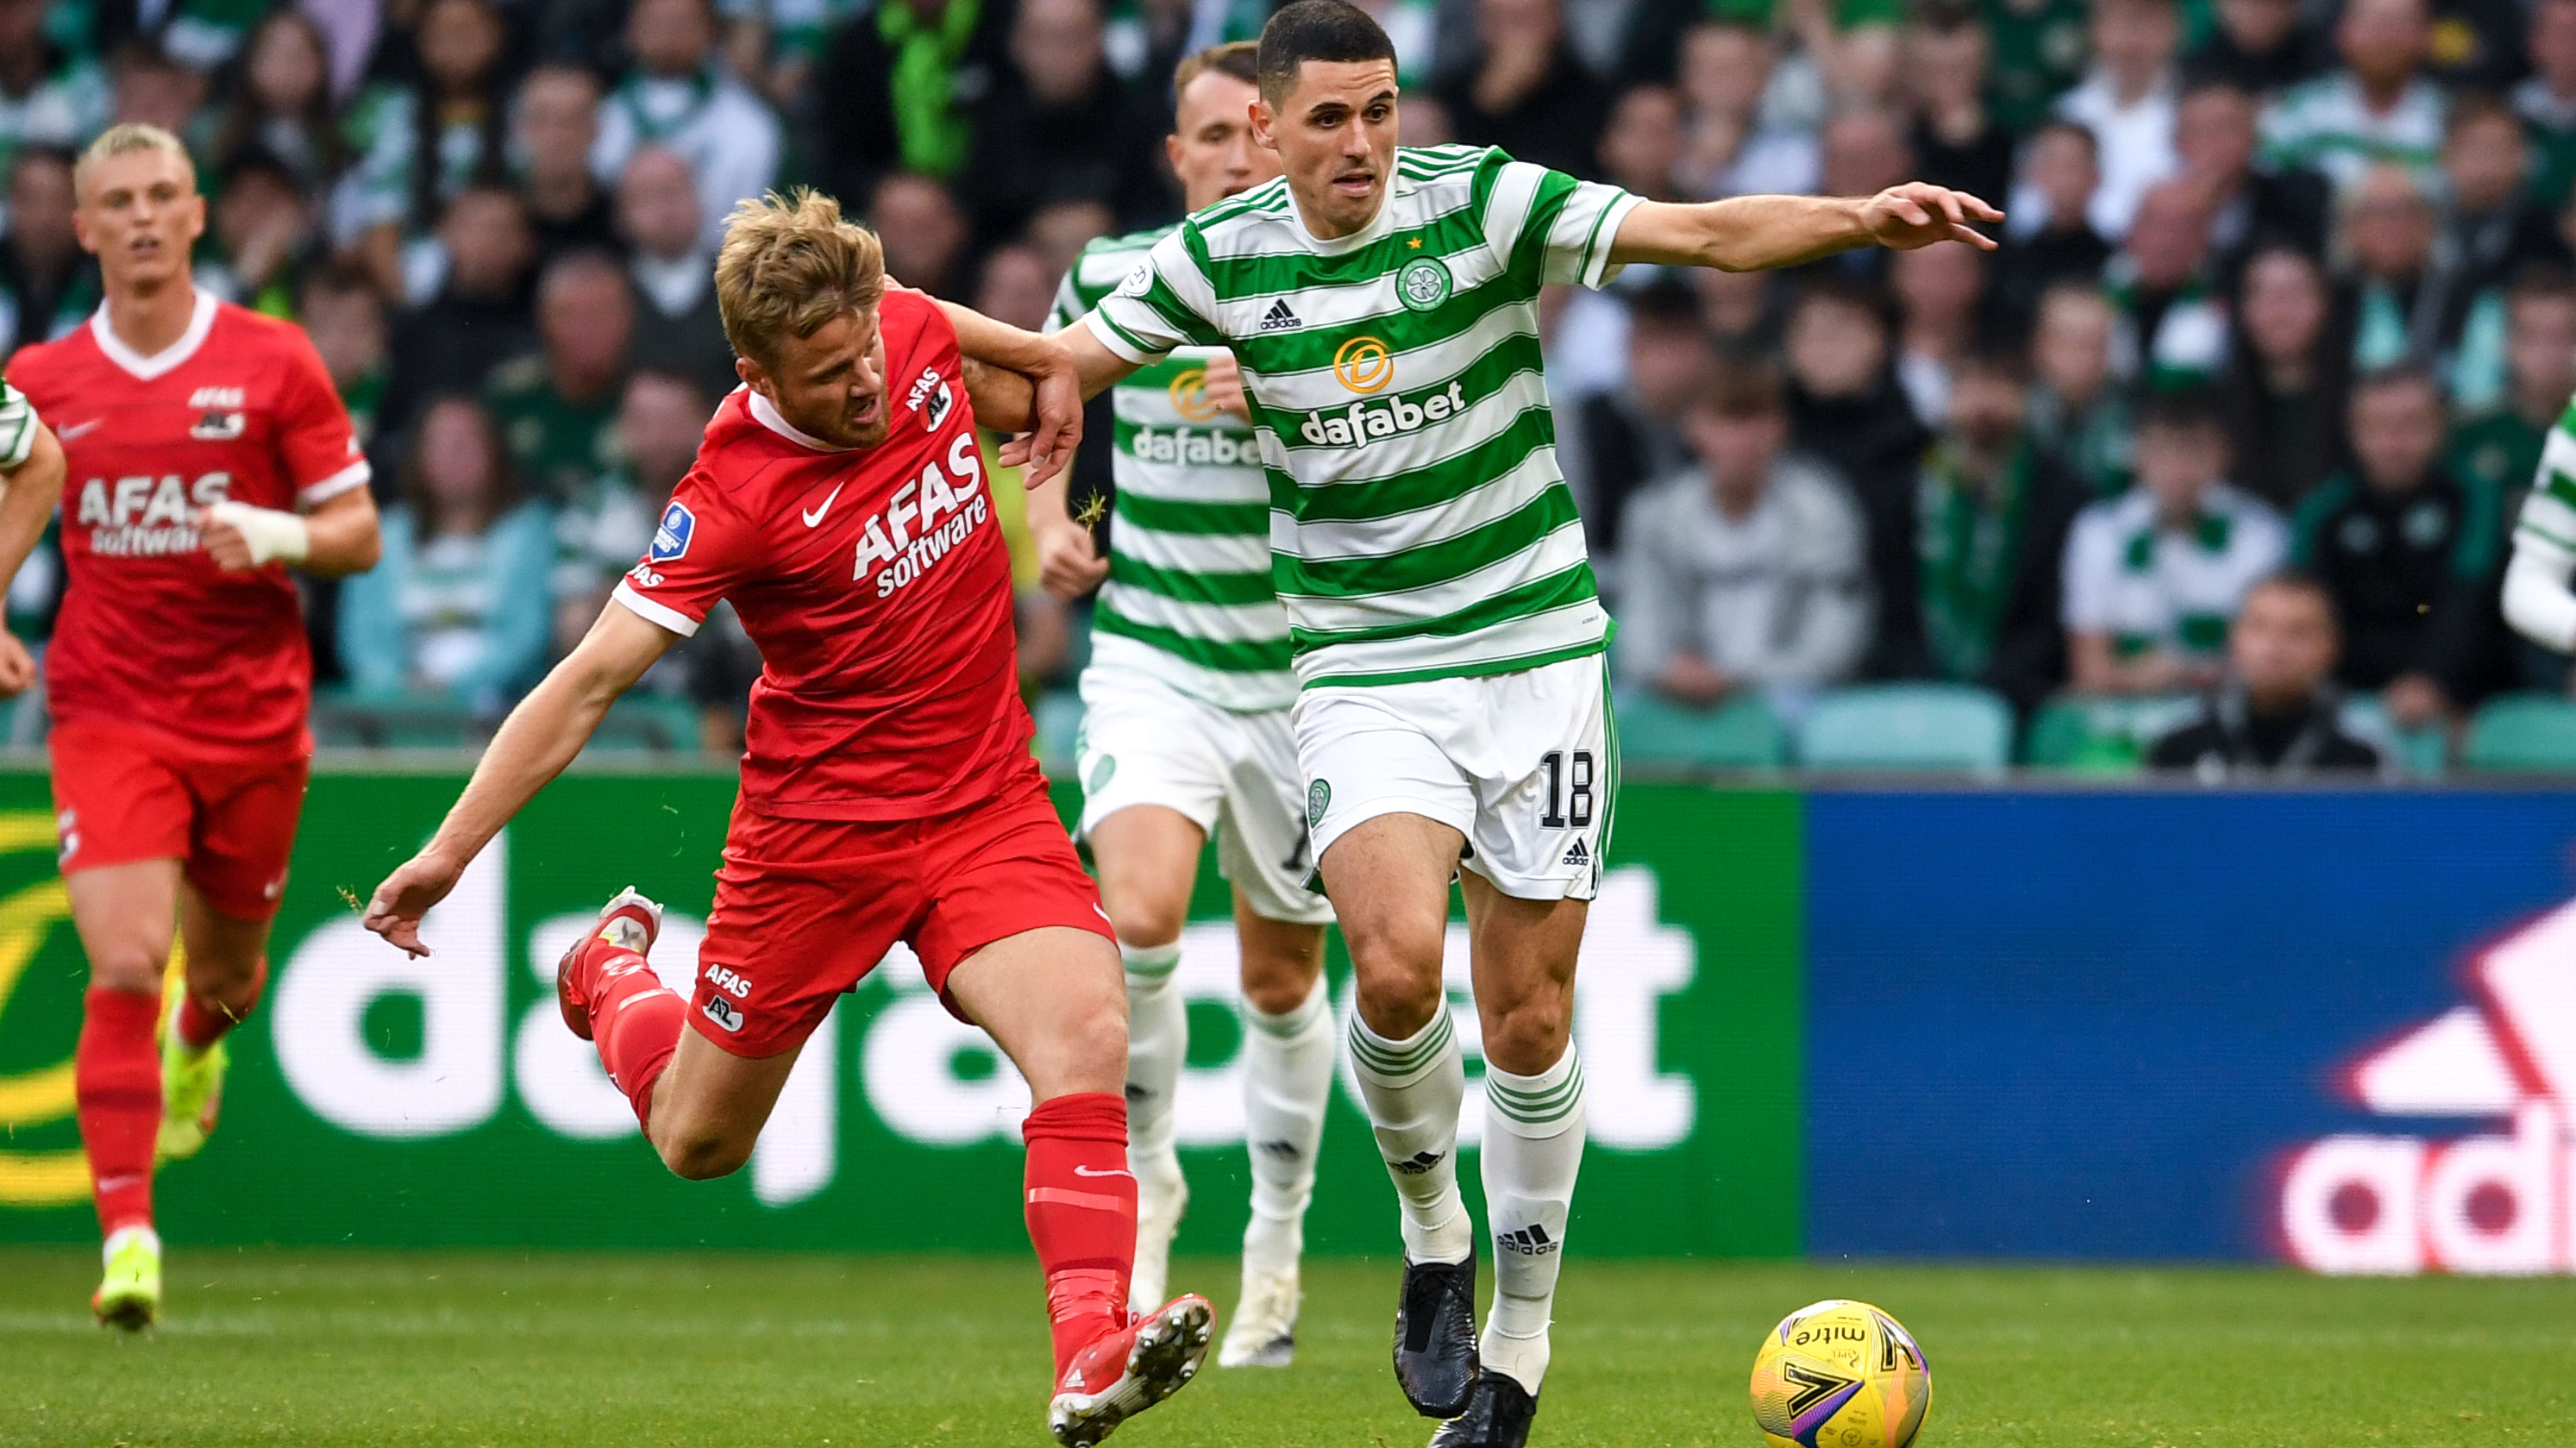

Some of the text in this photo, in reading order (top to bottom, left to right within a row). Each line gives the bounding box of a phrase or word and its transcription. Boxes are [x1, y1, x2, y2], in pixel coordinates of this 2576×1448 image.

[1260, 317, 1302, 330] adidas
[904, 366, 941, 412] AFAS
[1301, 380, 1466, 449] dafabet
[1132, 426, 1262, 466] dafabe
[852, 432, 981, 581] AFAS
[91, 524, 200, 555] softwar
[876, 493, 987, 599] software
[628, 562, 665, 587] AS
[1539, 749, 1595, 831] 18
[705, 963, 752, 998] AFAS
[270, 830, 1697, 1206] daat
[2279, 1100, 2576, 1275] ad
[1497, 1235, 1558, 1256] adidas
[1796, 1326, 1865, 1345] mitre
